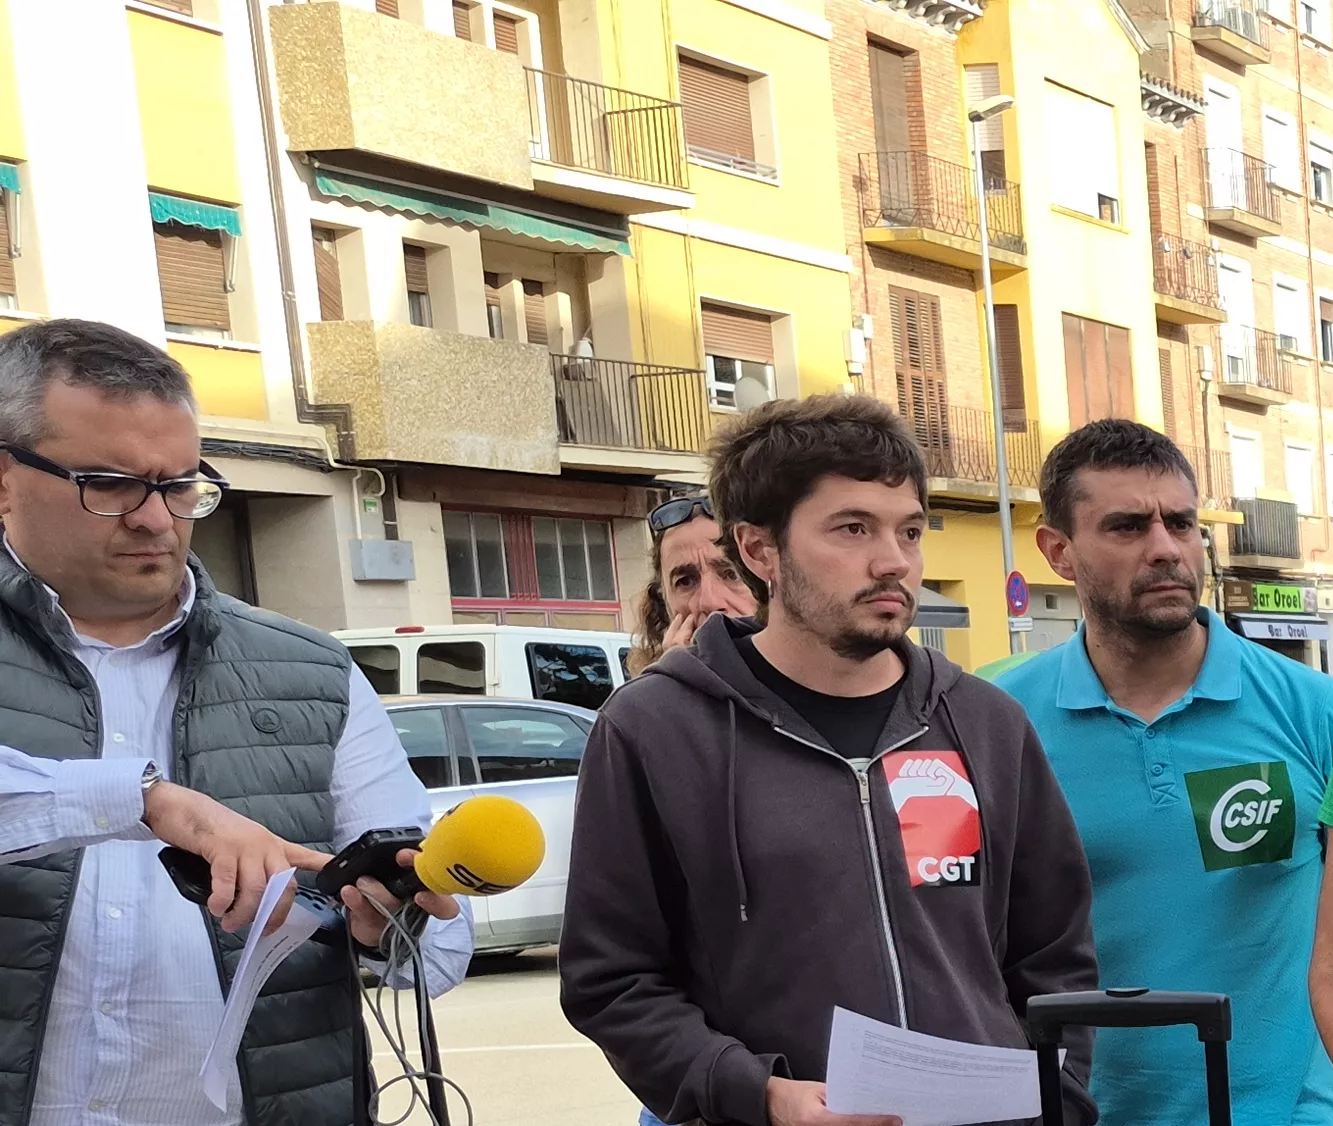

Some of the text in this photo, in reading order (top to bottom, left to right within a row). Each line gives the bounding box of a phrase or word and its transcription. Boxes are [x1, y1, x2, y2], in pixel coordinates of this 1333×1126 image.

[1252, 588, 1270, 606] Bar
[1273, 588, 1302, 609] Oroel
[1267, 624, 1283, 638] Bar
[1224, 798, 1284, 829] CSIF
[917, 855, 976, 882] CGT
